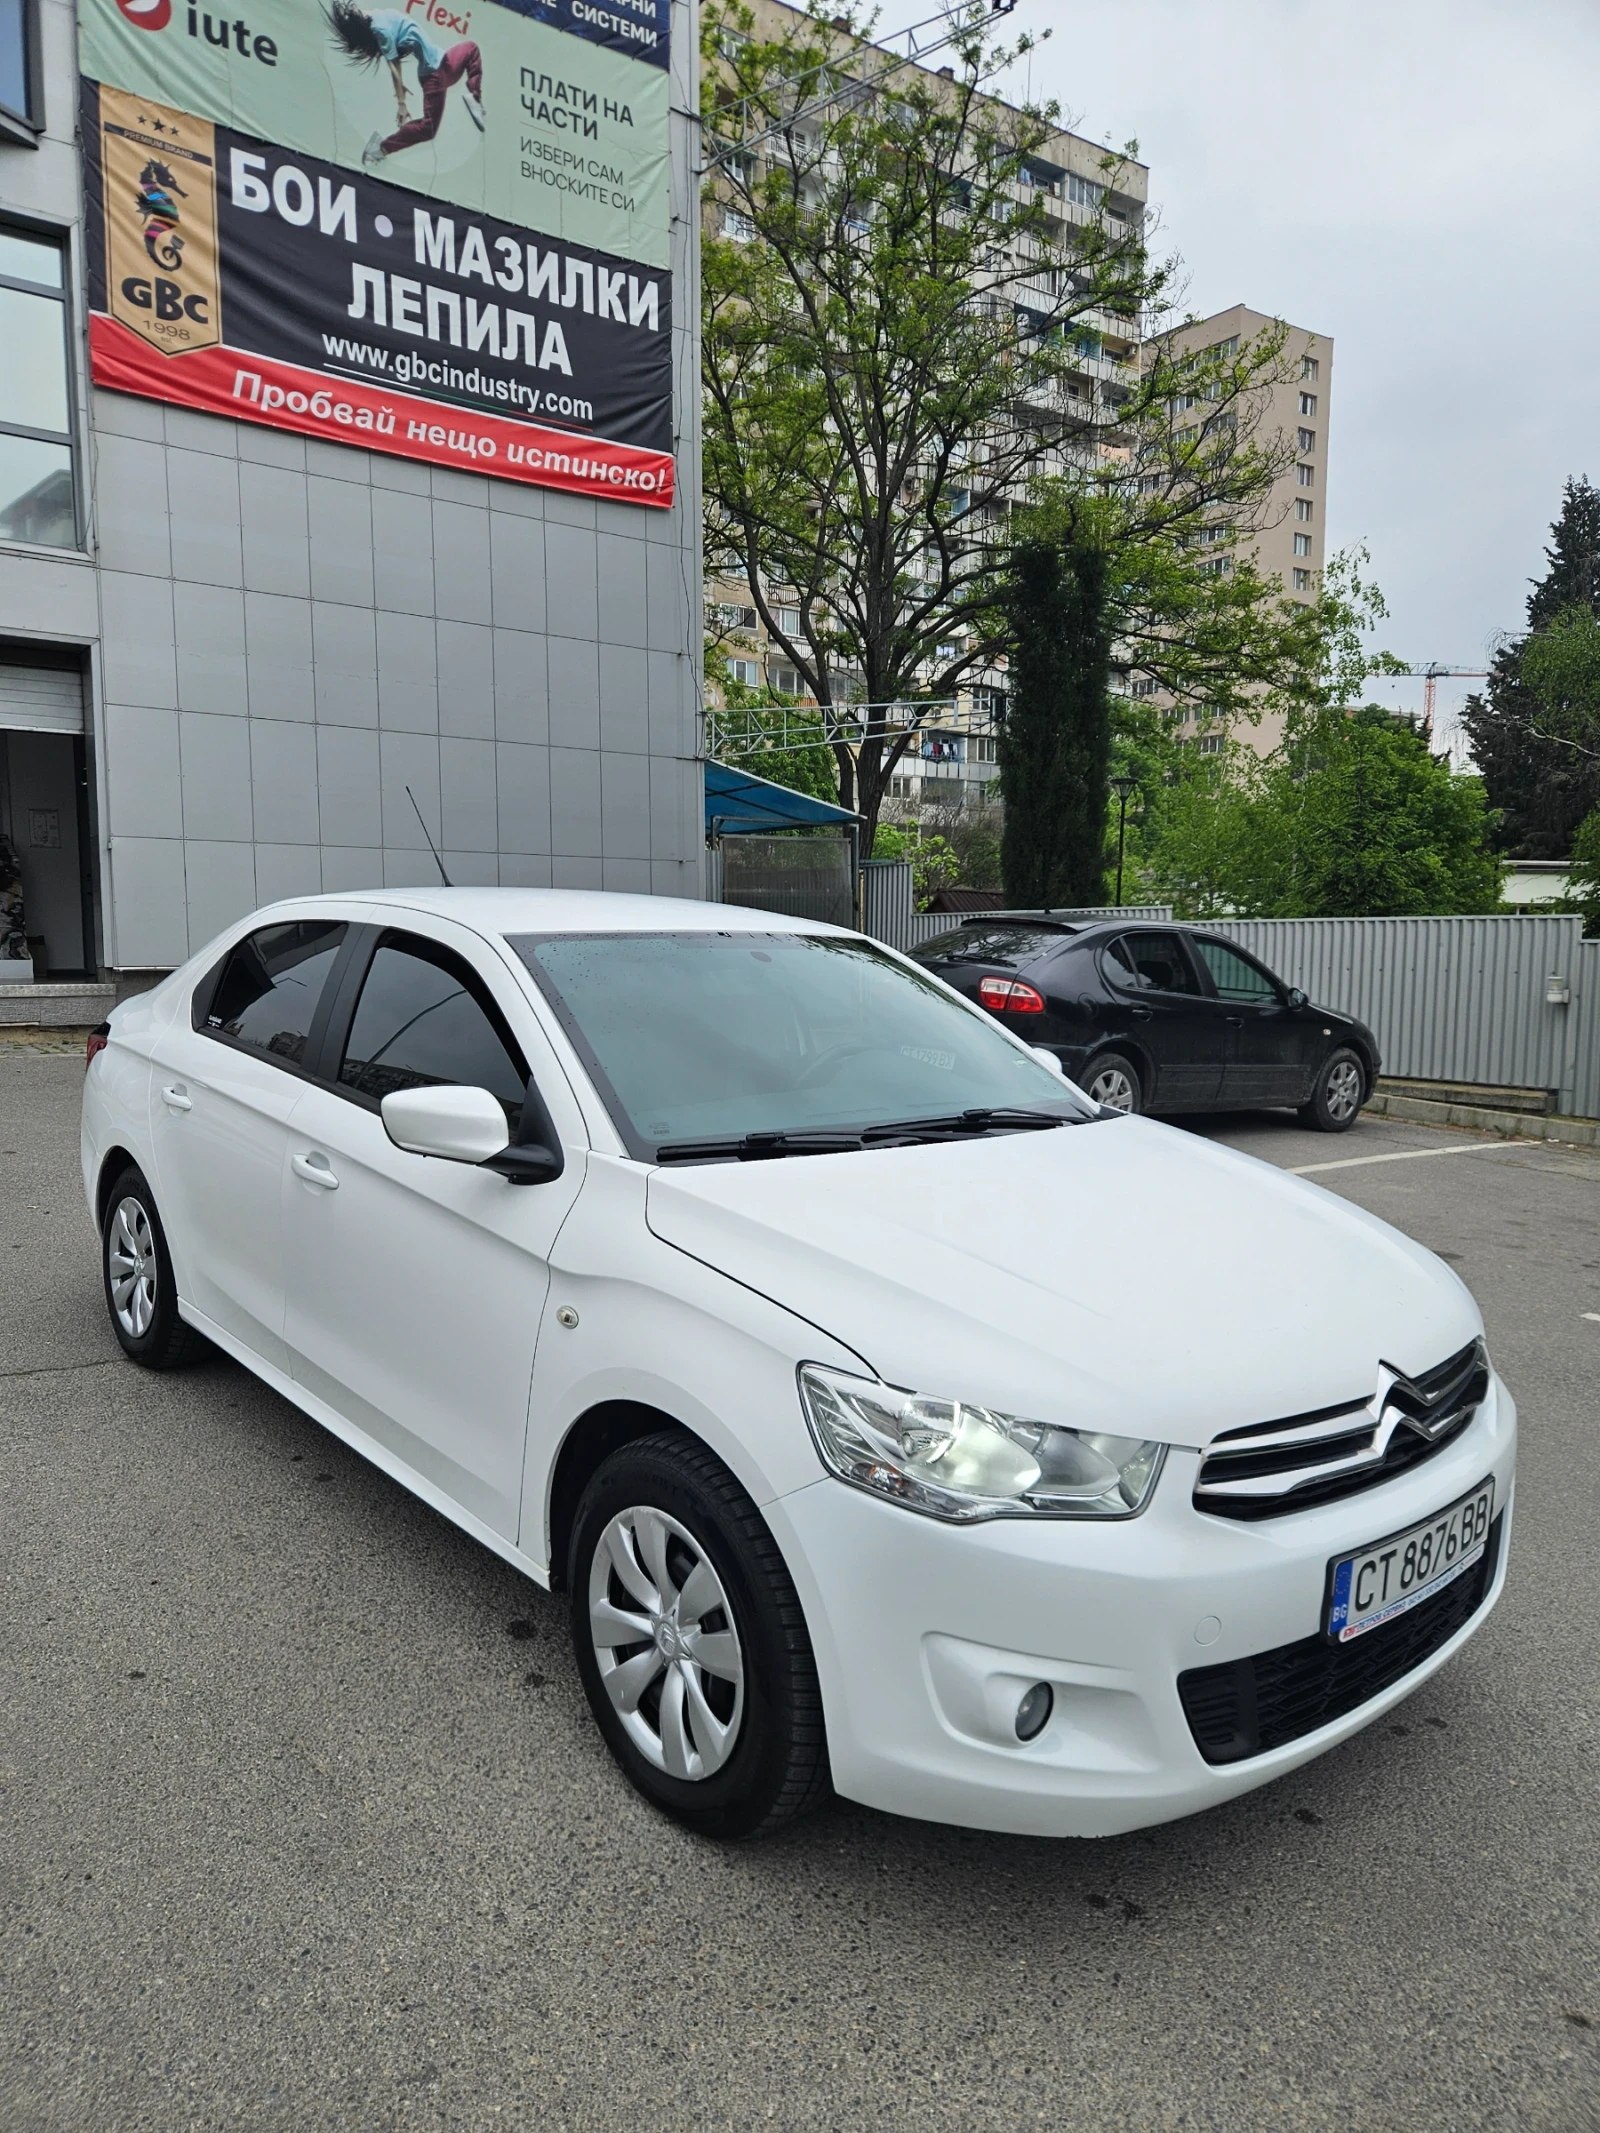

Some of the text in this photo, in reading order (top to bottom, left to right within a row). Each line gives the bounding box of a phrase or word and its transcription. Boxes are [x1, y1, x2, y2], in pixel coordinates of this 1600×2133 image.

[187, 0, 278, 66] iute
[571, 2, 657, 47] СИСТЕМИ
[520, 66, 634, 127] ПЛАТИ НА
[521, 93, 597, 140] ЧАСТИ
[123, 130, 193, 159] PREMIUM BRAND
[520, 136, 623, 186] ИЗБЕРИ САМ
[521, 160, 635, 213] ВНОСКИТЕ СИ
[230, 147, 659, 332] БОИ МАЗИЛКИ
[121, 277, 208, 324] GBC
[347, 262, 573, 376] ЛЕПИЛА
[143, 320, 190, 340] 1998
[322, 334, 593, 420] www.gbcindustry.com
[232, 370, 665, 492] Пробвай нещо истинско!
[1355, 1549, 1398, 1612] CT
[1401, 1514, 1457, 1589] 8876
[1461, 1494, 1488, 1552] BB
[1333, 1603, 1348, 1622] BG
